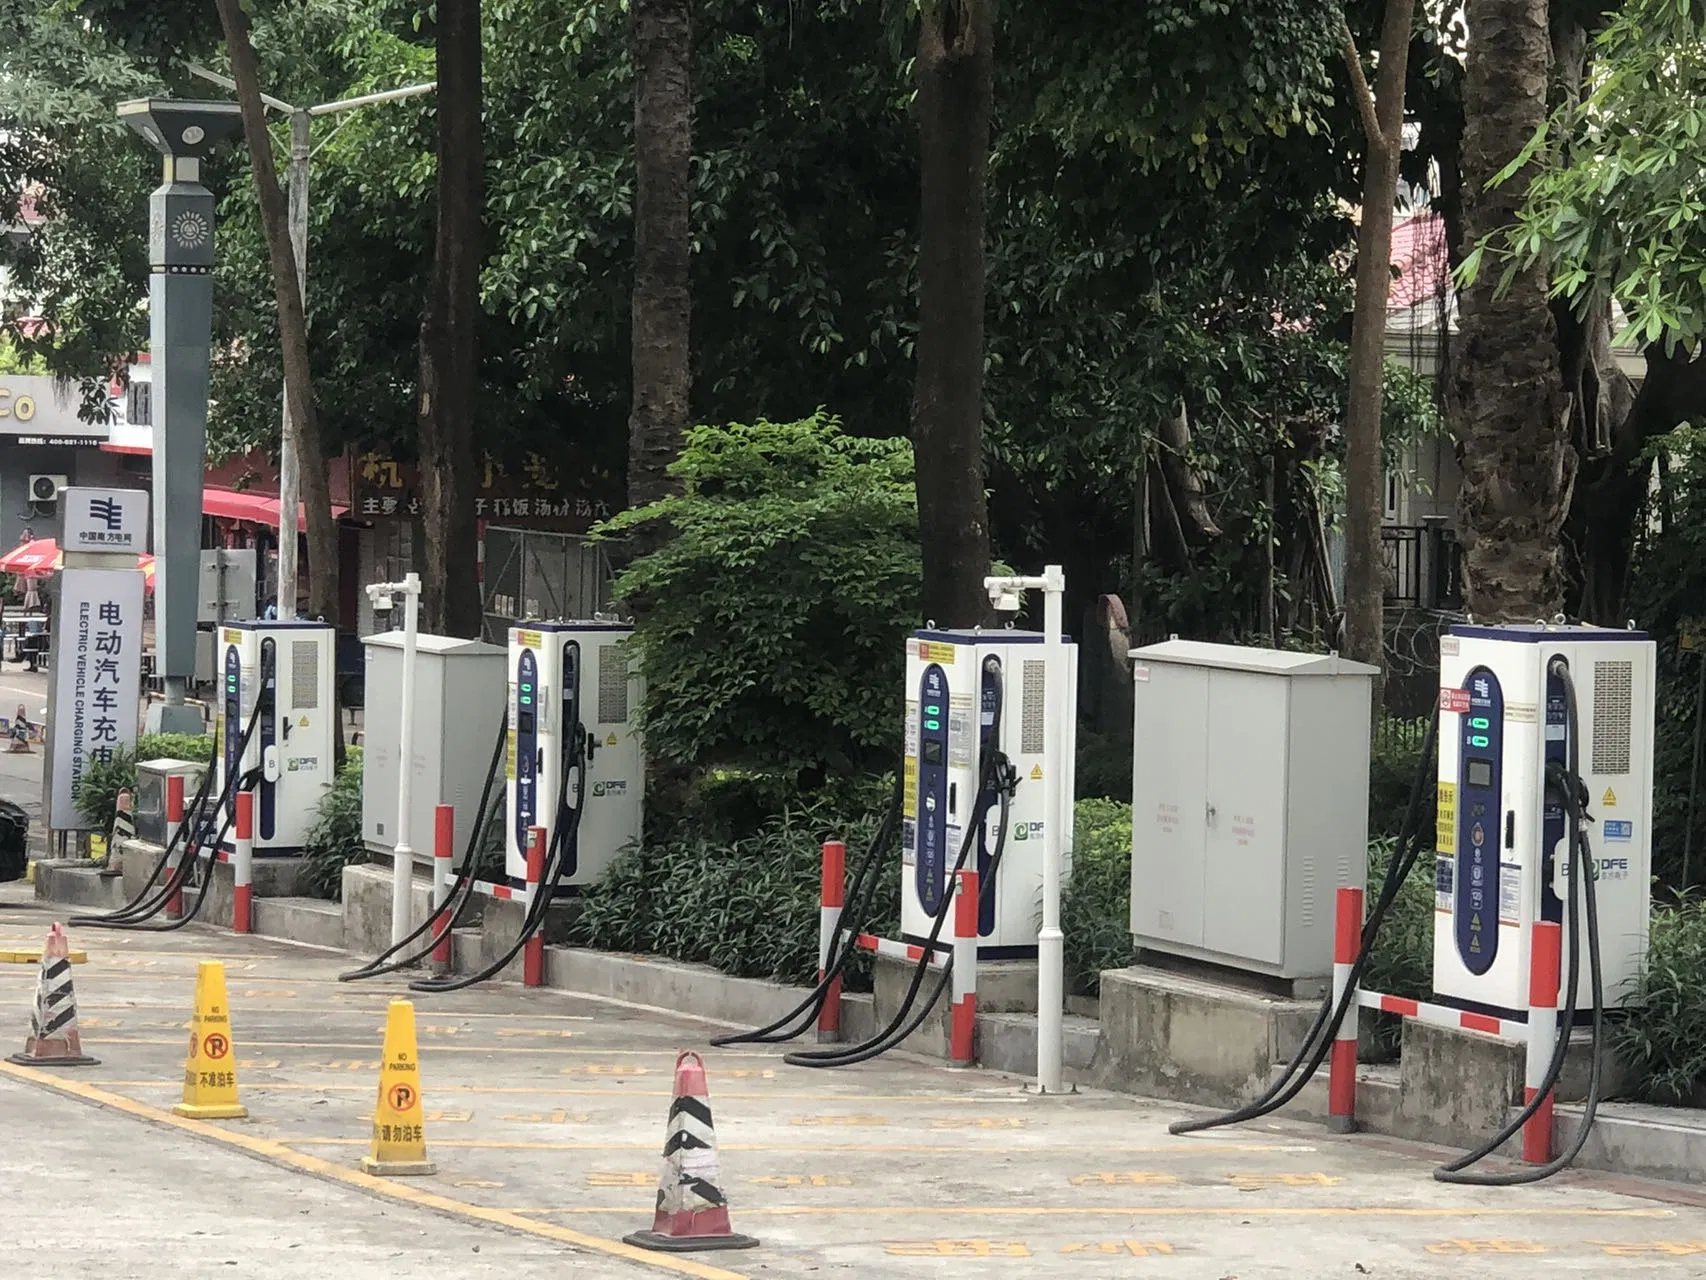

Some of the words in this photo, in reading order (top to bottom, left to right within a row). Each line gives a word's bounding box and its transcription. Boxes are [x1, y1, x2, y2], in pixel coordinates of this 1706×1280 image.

[79, 531, 132, 543] 中国南方电网
[77, 601, 90, 654] ELECTRIC
[75, 654, 88, 698] VEHICLE
[72, 699, 85, 757] CHARGING
[70, 757, 82, 800] STATION
[606, 780, 627, 789] DFE
[1601, 858, 1628, 870] DFE
[398, 1052, 408, 1061] NO
[389, 1063, 417, 1072] PARKING
[200, 1071, 235, 1088] 不准泊车
[382, 1124, 423, 1142] 请勿泊车
